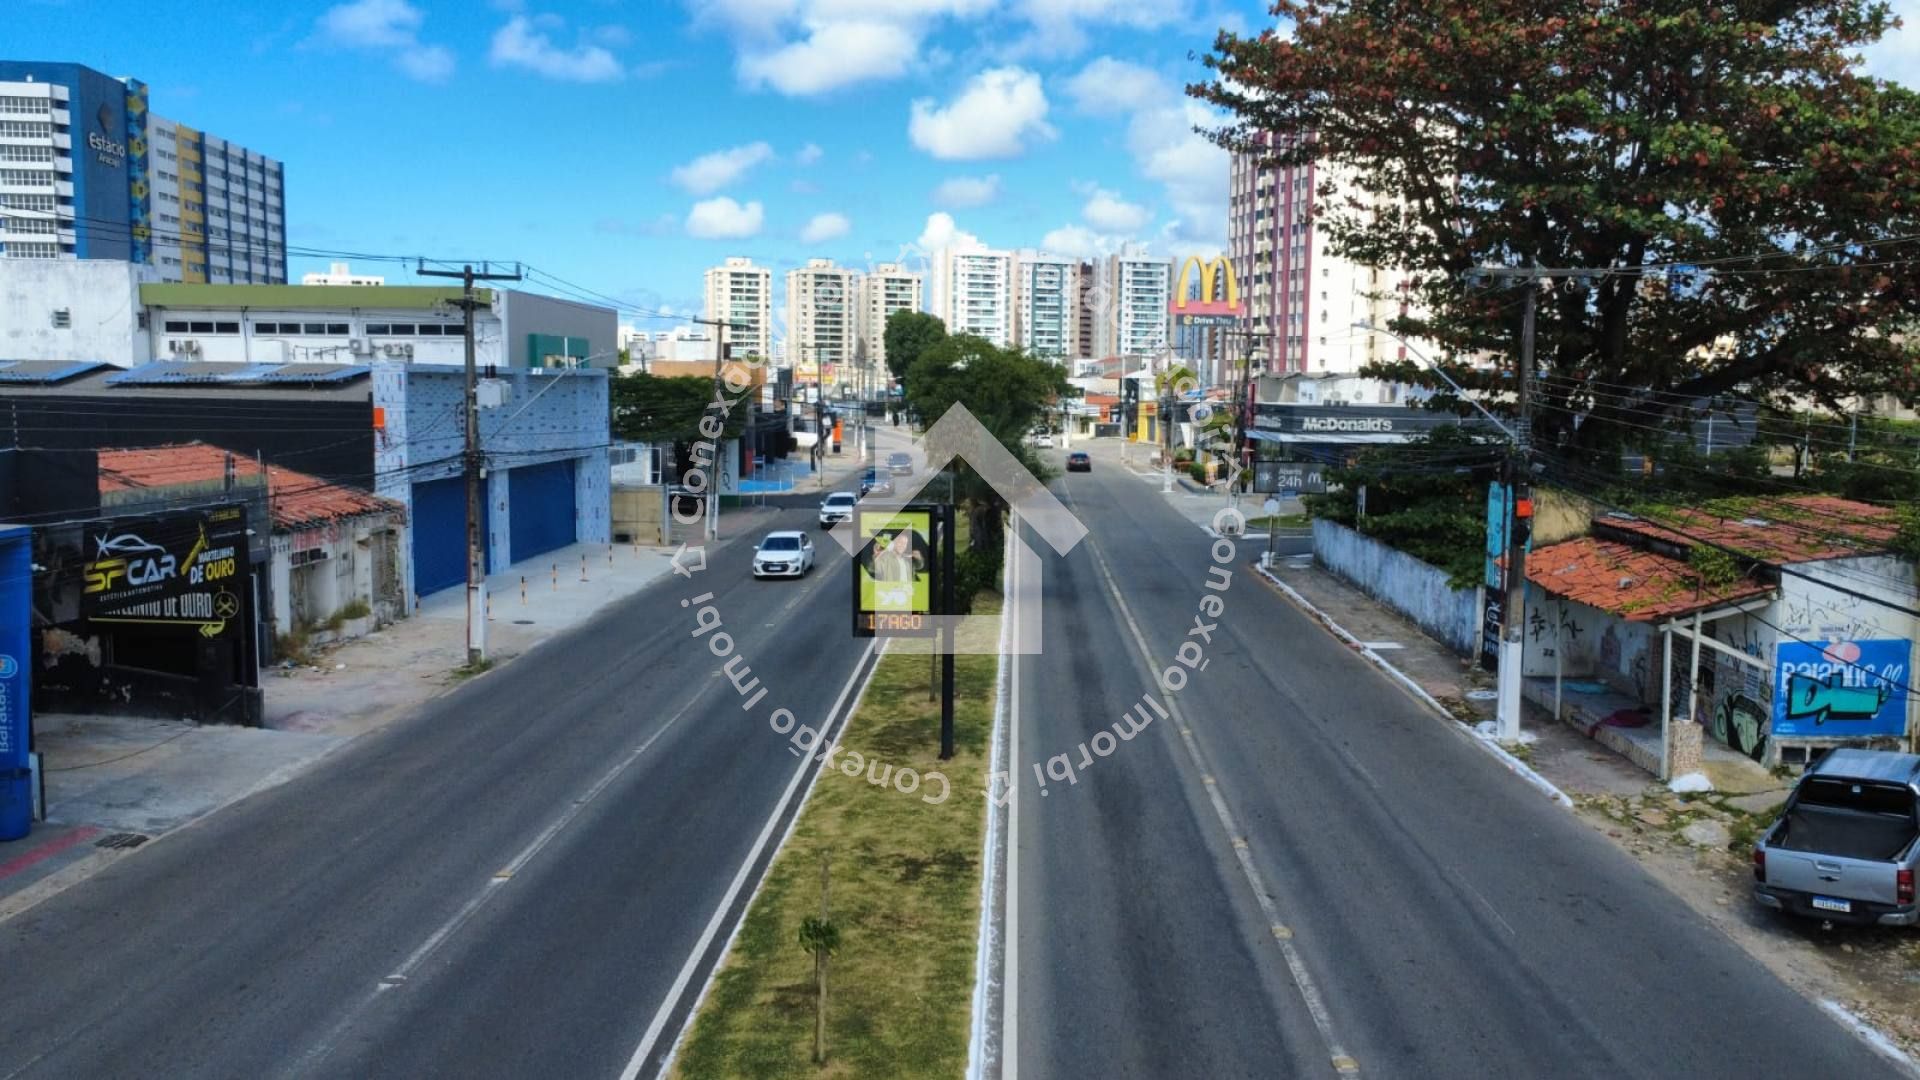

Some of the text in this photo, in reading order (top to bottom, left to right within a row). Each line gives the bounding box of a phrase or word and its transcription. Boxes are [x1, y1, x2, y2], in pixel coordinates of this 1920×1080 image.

[1194, 316, 1214, 324] Drive
[1302, 416, 1393, 432] McDonald's
[1277, 476, 1302, 488] 24h
[190, 558, 235, 585] DE OURO
